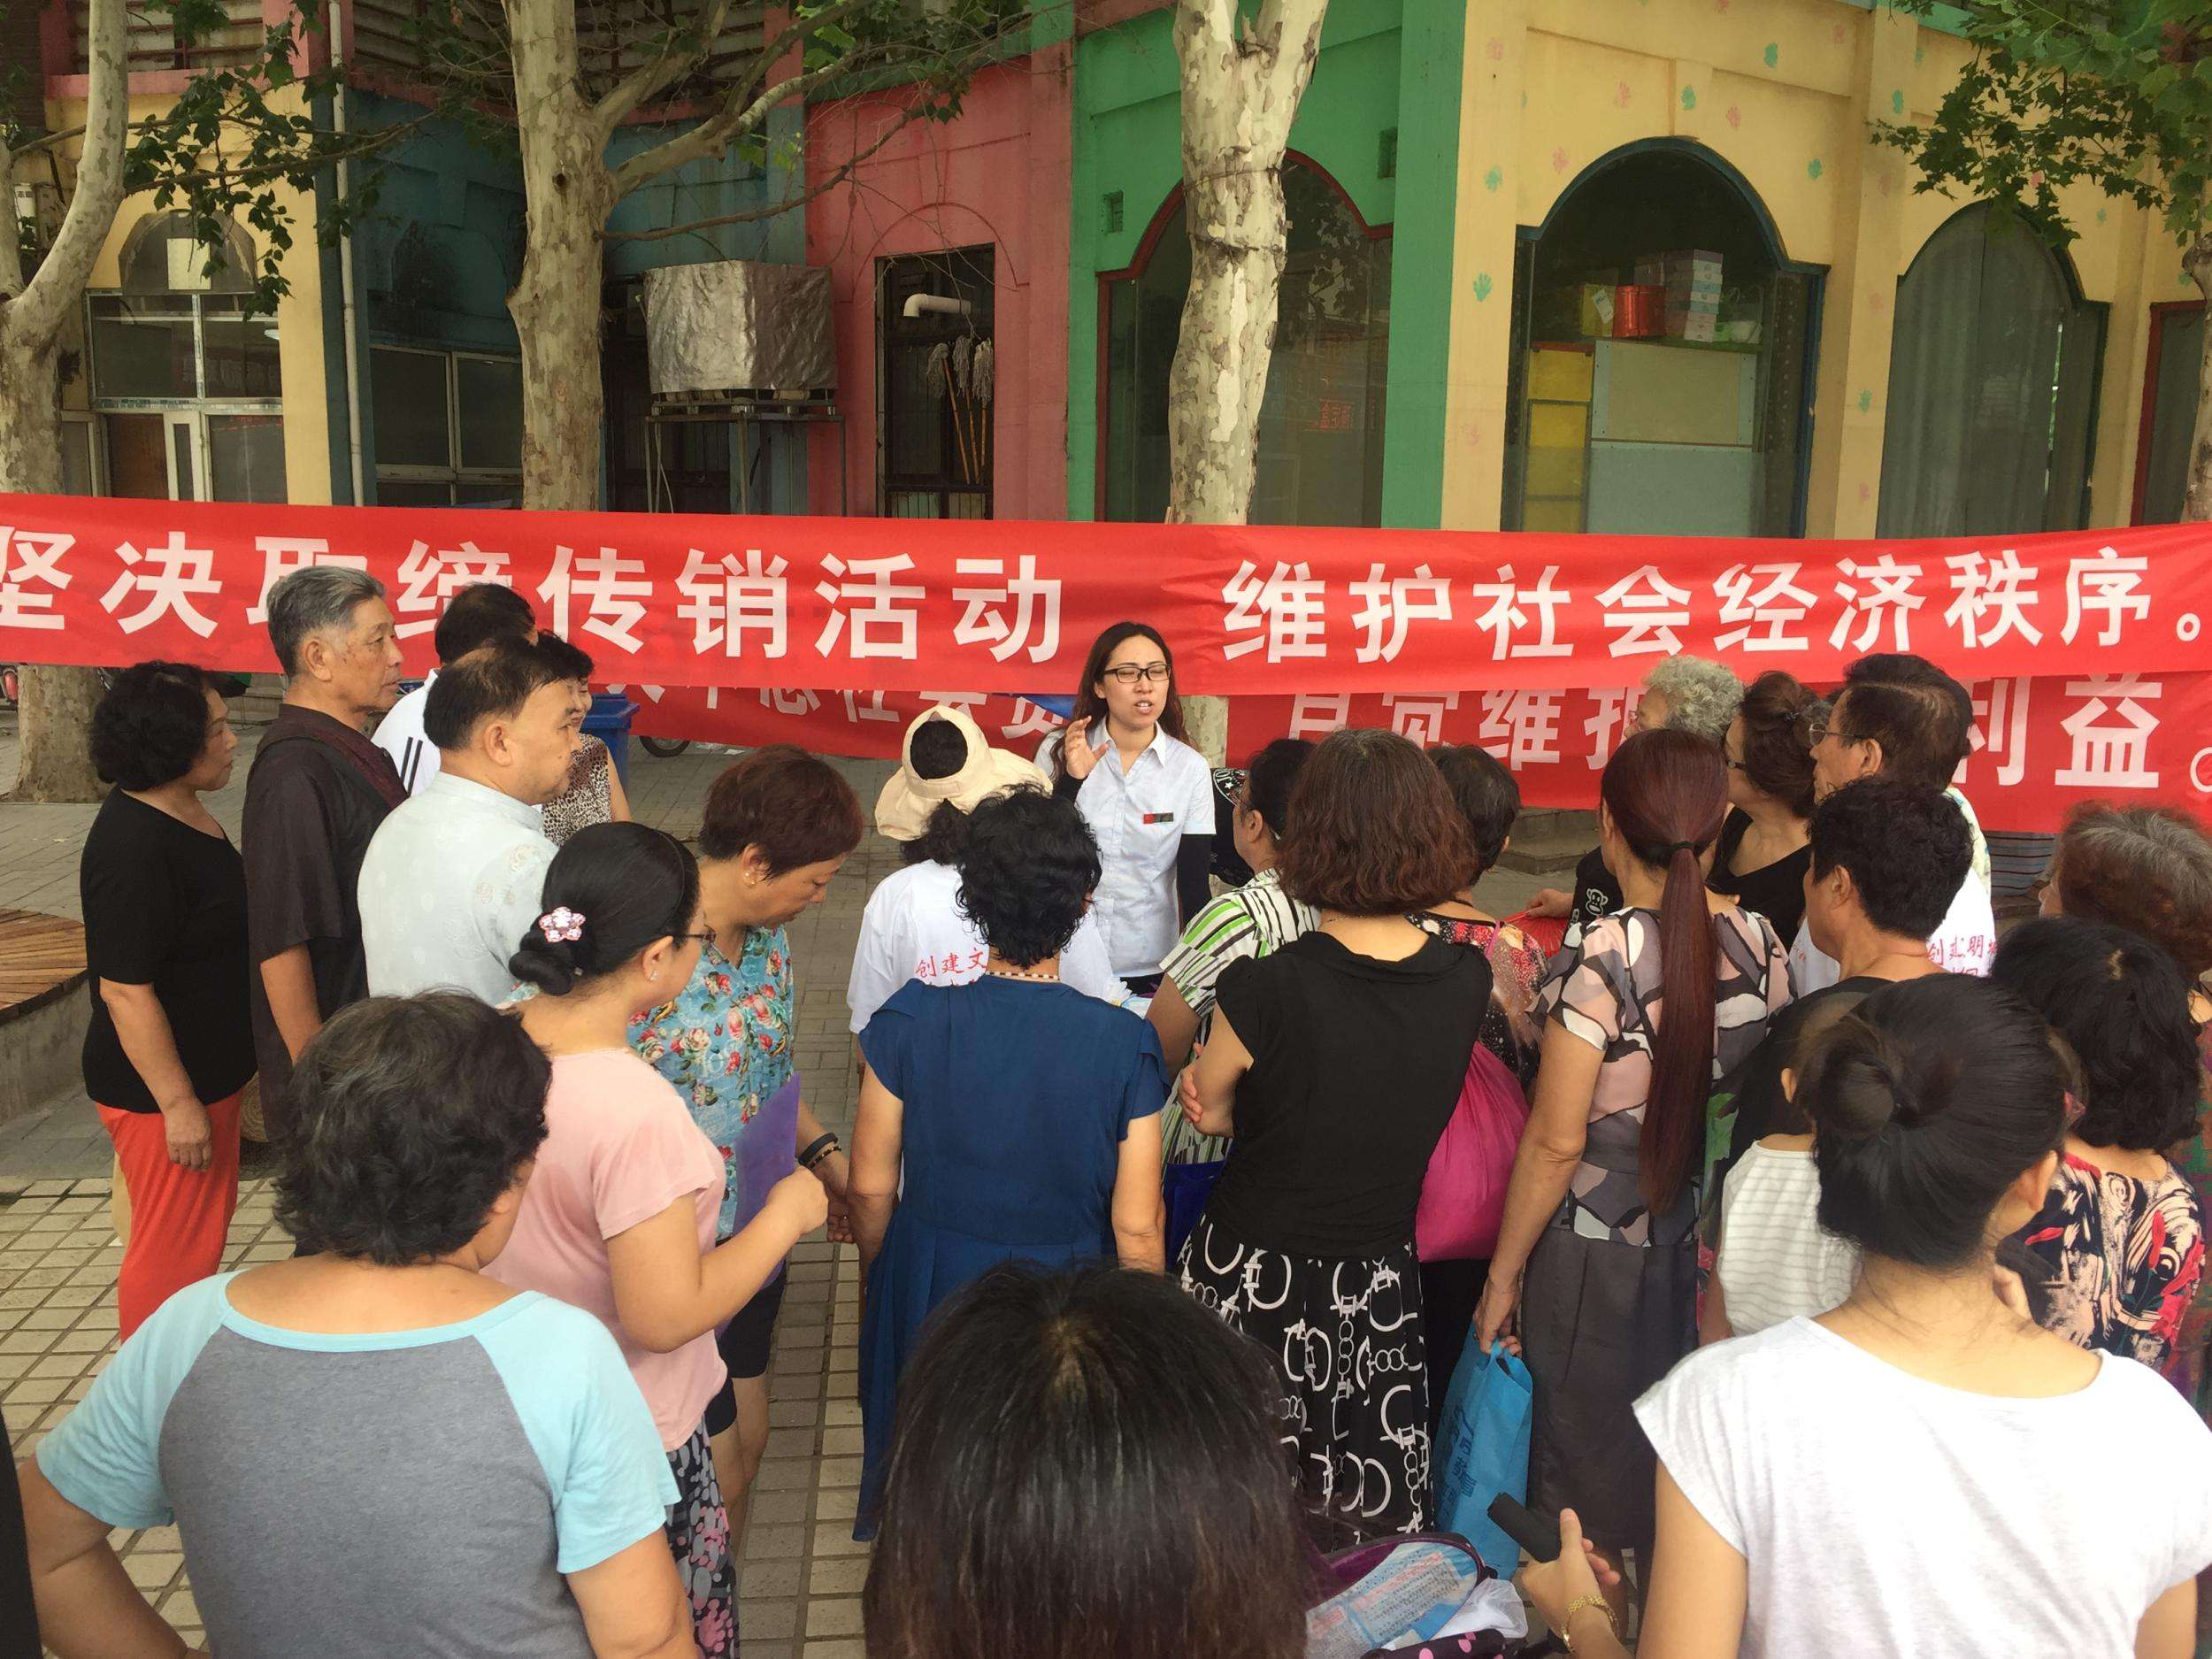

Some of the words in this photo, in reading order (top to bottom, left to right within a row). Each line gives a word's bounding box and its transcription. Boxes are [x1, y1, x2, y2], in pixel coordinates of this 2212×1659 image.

[1222, 546, 2200, 663] 维护社会经济秩序。
